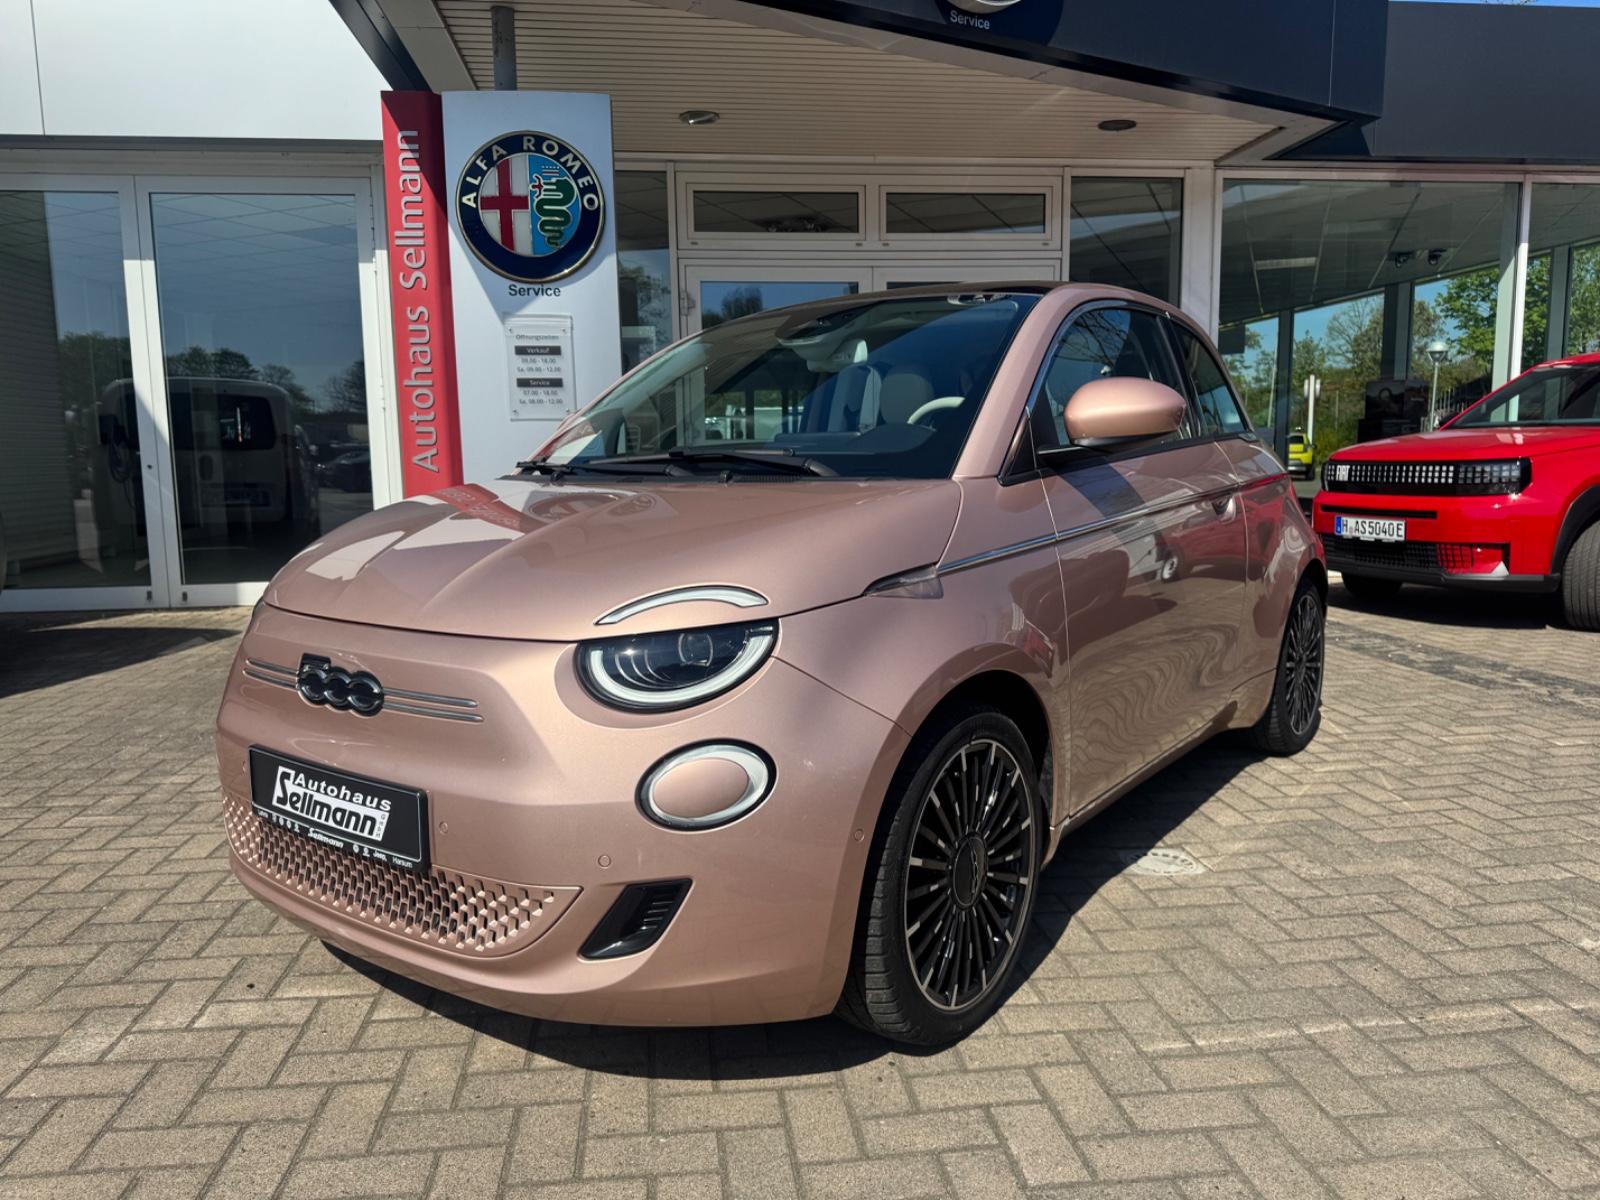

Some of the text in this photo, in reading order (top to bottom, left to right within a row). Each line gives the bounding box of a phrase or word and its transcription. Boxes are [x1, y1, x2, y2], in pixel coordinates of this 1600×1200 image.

[950, 10, 991, 30] Service
[461, 135, 599, 211] ALFA ROMEO
[394, 130, 440, 473] Autohaus Sellmann
[508, 284, 561, 297] Service
[1336, 464, 1351, 481] FIAT
[297, 652, 385, 718] 500
[276, 770, 378, 837] Sellmann
[293, 771, 393, 812] Autohaus
[307, 827, 345, 849] Sellmann
